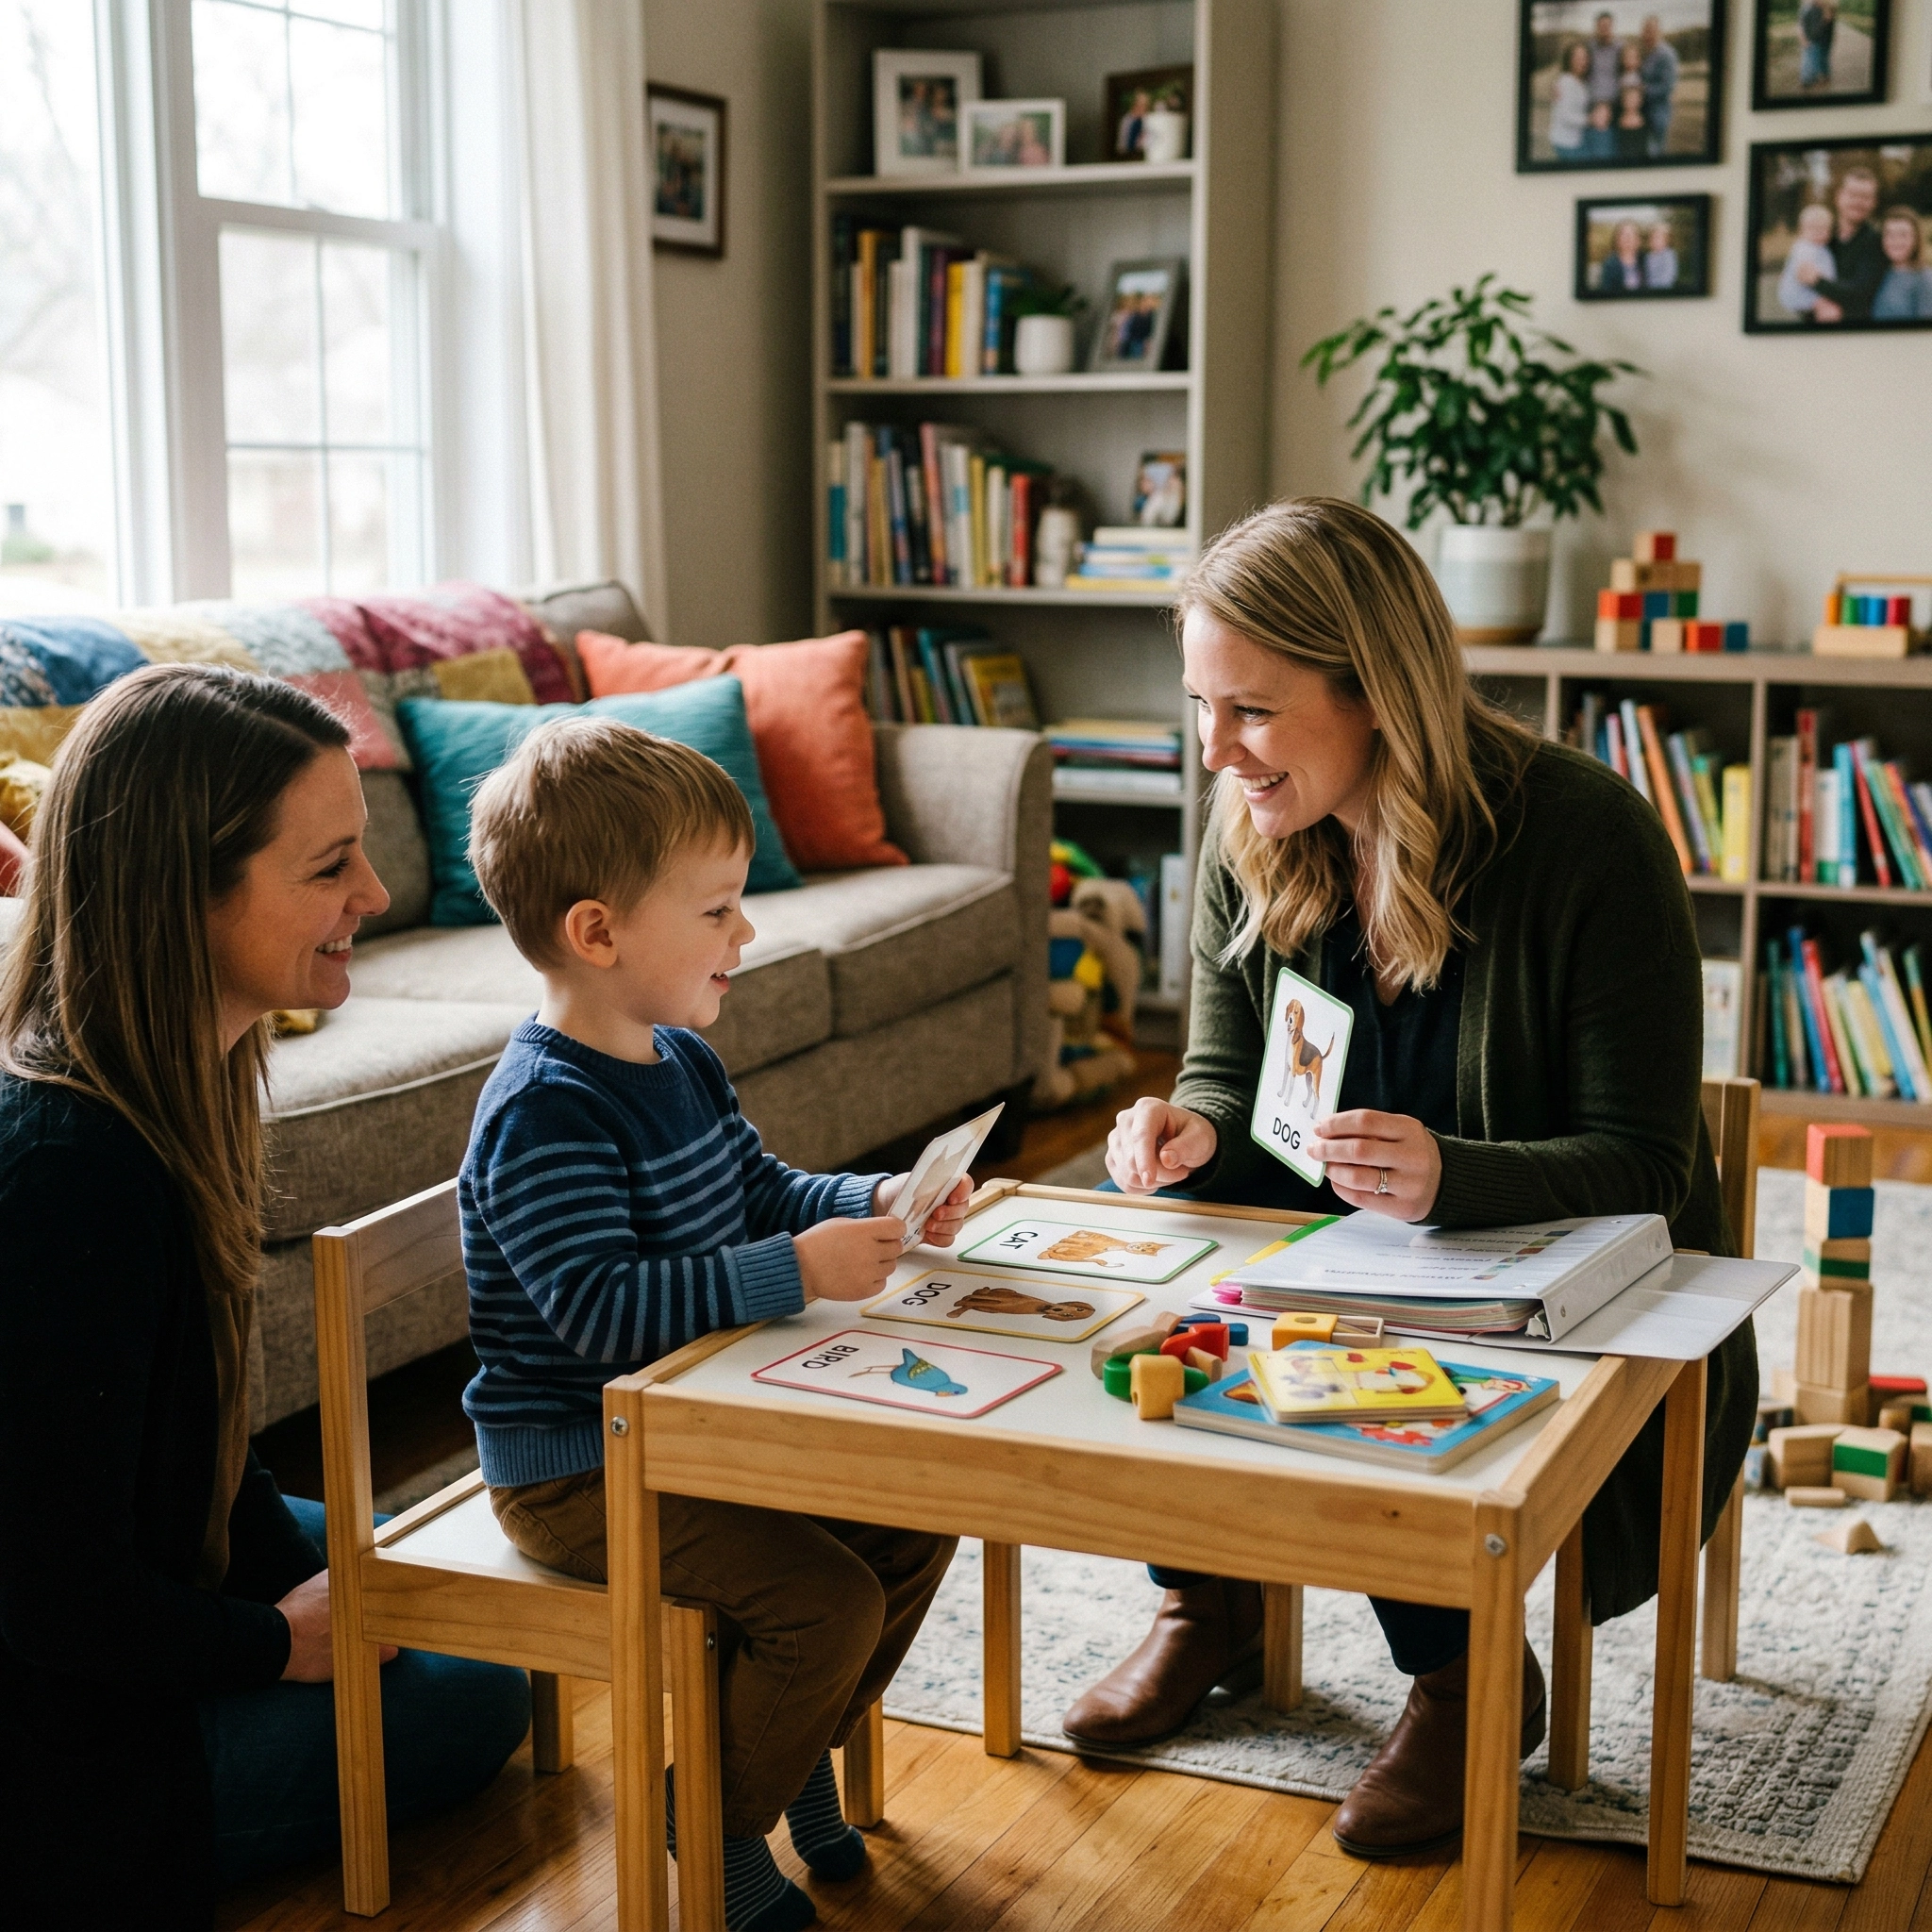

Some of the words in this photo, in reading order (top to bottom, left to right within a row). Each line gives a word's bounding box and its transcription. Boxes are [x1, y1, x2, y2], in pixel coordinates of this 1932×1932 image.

[1273, 1117, 1301, 1150] DOG
[999, 1231, 1039, 1250] CAT
[902, 1282, 952, 1307] DOG
[802, 1344, 860, 1369] BIRD
